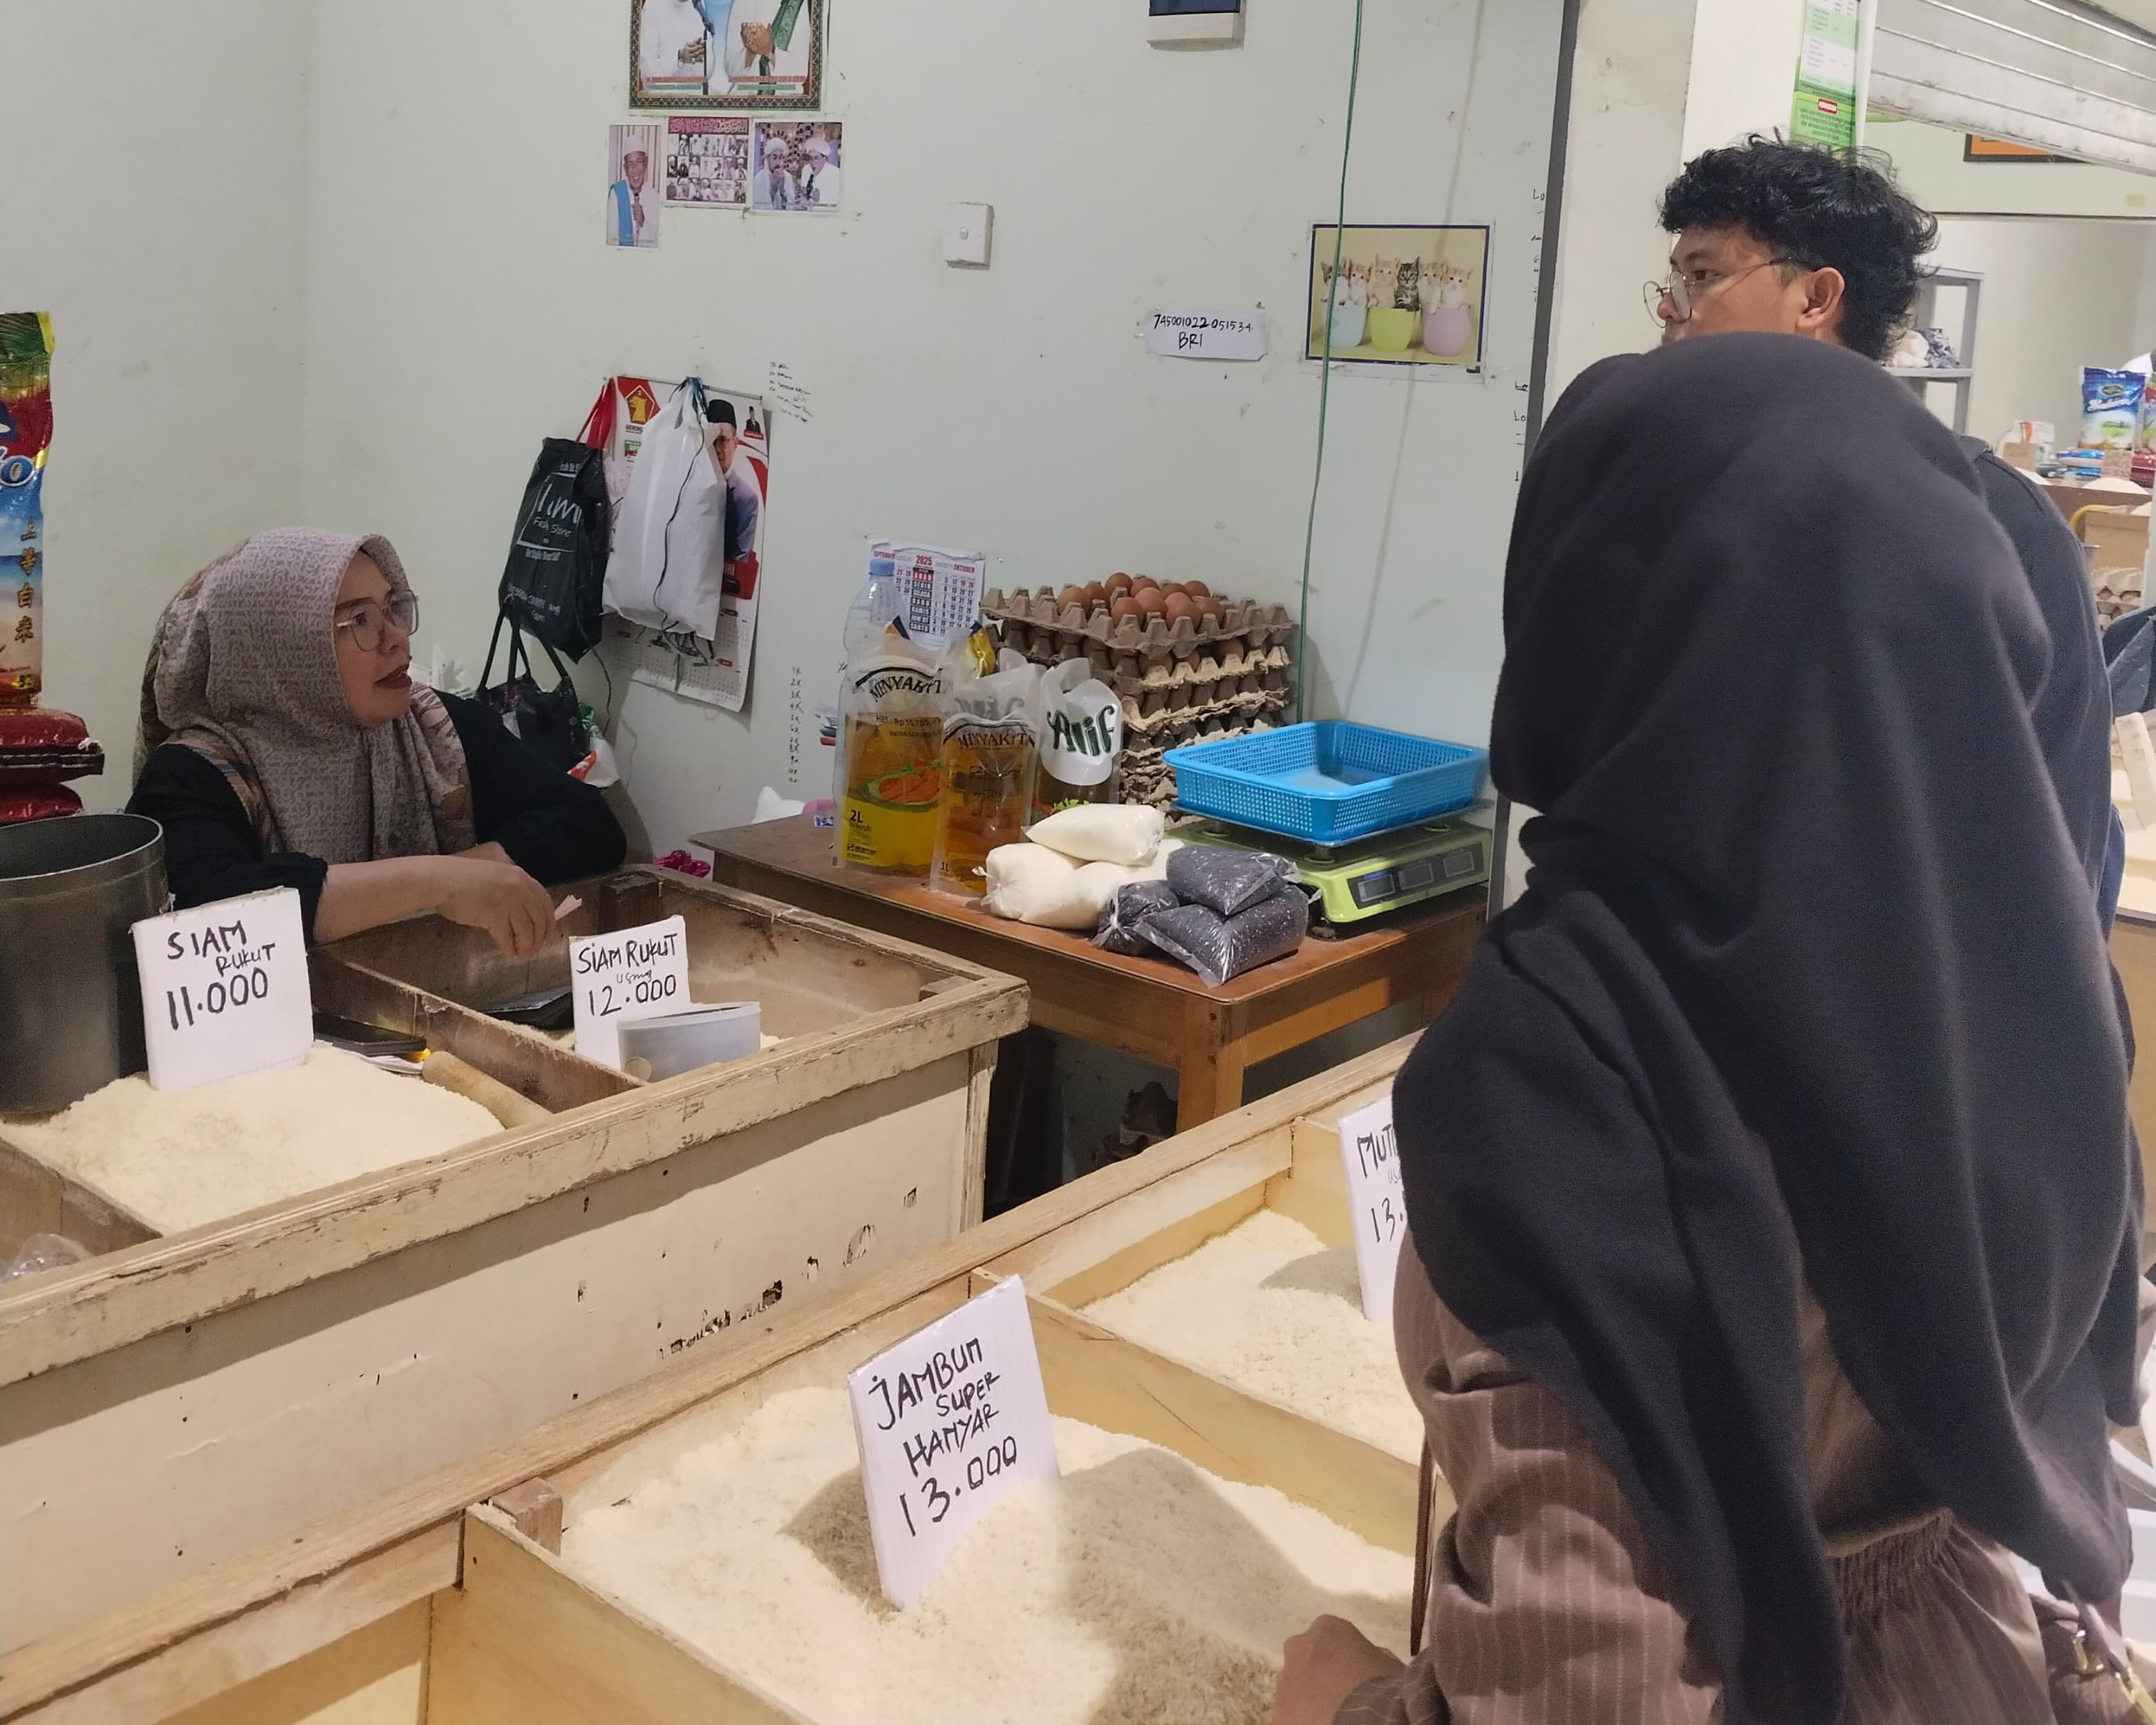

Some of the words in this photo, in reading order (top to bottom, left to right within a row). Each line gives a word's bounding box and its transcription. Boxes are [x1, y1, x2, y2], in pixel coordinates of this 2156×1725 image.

[1179, 331, 1203, 350] BRI
[917, 555, 932, 566] 2025
[1046, 705, 1116, 757] Alif
[850, 809, 863, 824] 2L
[167, 920, 247, 960] SIAM
[215, 943, 276, 977] RUKUT
[626, 933, 678, 968] RUKUT
[166, 967, 269, 1031] 11.000
[588, 974, 677, 1017] 12.000
[935, 1370, 1002, 1418] SUPER
[899, 1435, 1018, 1538] 13.000
